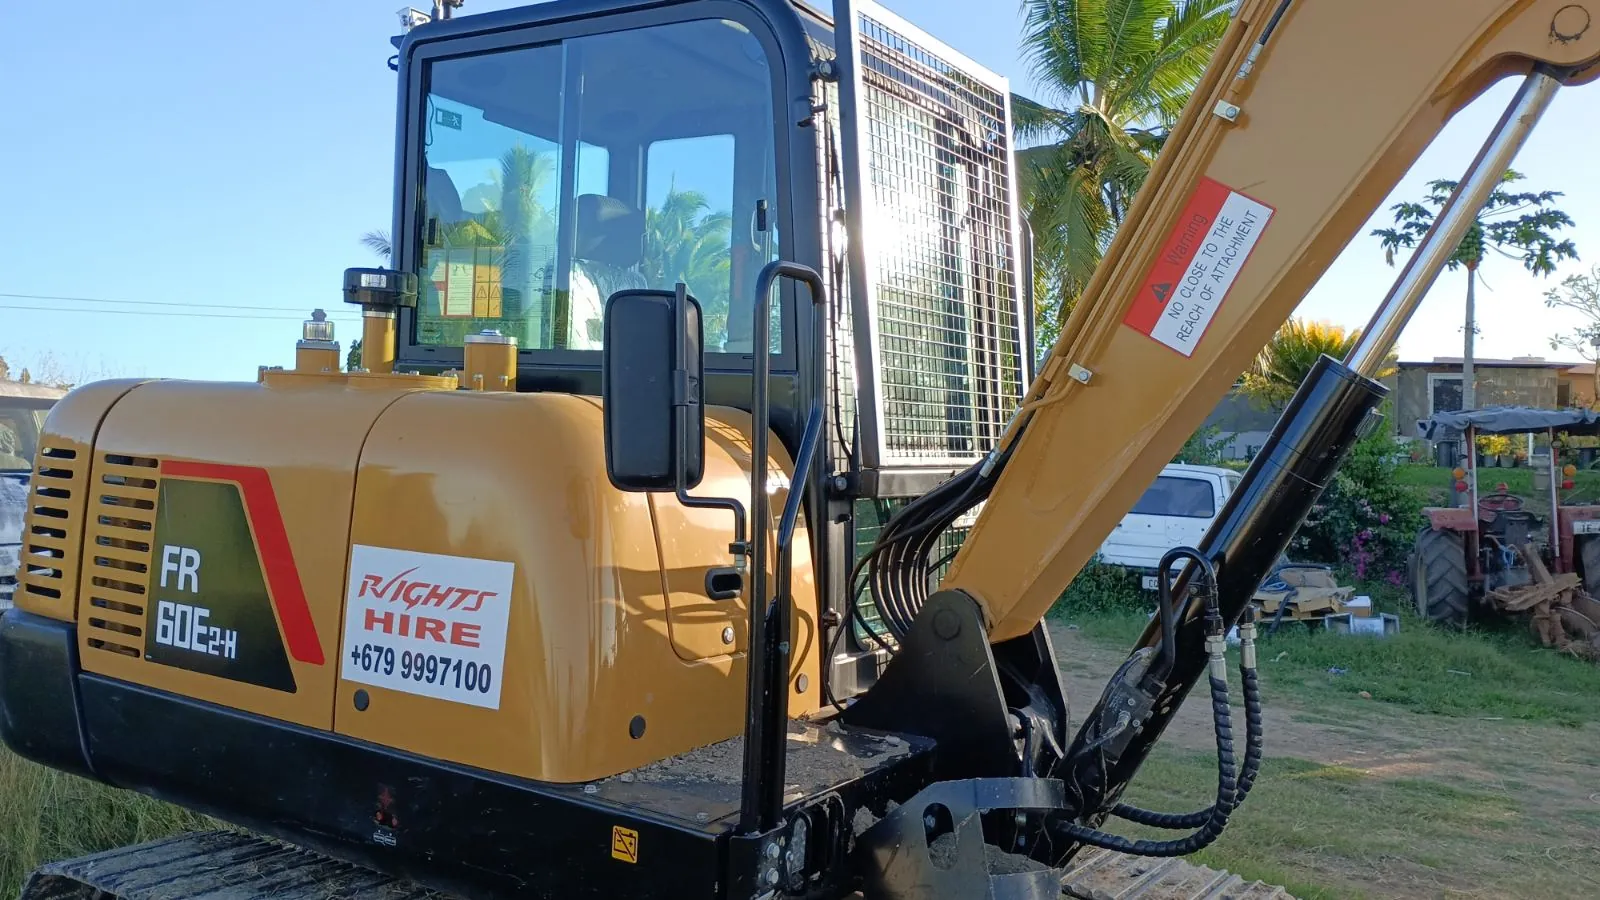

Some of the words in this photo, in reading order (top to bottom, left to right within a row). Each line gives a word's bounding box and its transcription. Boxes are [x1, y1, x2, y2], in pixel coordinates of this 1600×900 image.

[1166, 214, 1209, 266] Warning
[1168, 302, 1184, 320] NO
[1180, 261, 1207, 299] CLOSE
[1202, 242, 1218, 262] TO
[1213, 215, 1234, 240] THE
[1176, 305, 1205, 342] REACH
[1200, 285, 1215, 301] OF
[1211, 210, 1258, 283] ATTACHMENT
[160, 545, 201, 593] FR
[364, 608, 481, 648] HIRE
[351, 643, 395, 676] +679
[401, 650, 492, 694] 9997100
